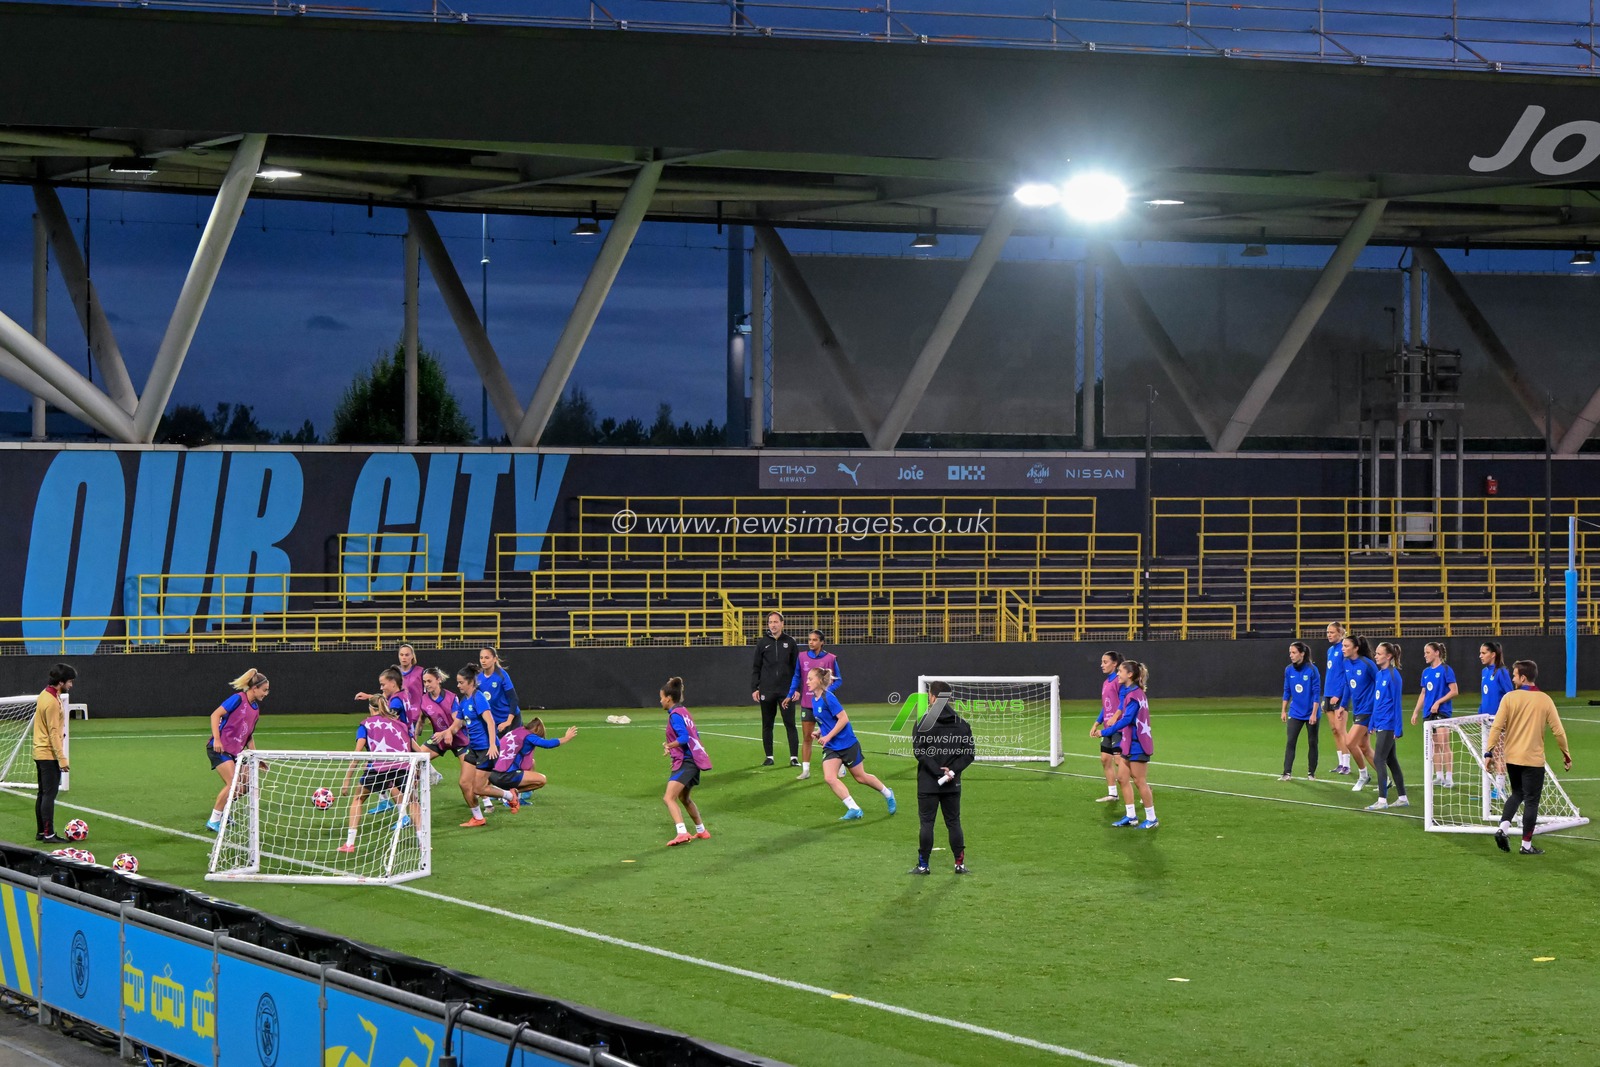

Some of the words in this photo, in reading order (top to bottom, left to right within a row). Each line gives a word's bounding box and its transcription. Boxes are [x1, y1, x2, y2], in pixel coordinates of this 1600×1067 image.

[769, 466, 816, 474] ETIHAD
[898, 465, 924, 480] Joie
[948, 466, 985, 480] OKX
[1027, 467, 1049, 478] Asahi
[1066, 469, 1125, 478] NISSAN
[22, 451, 304, 655] OUR
[346, 452, 570, 601] CITY
